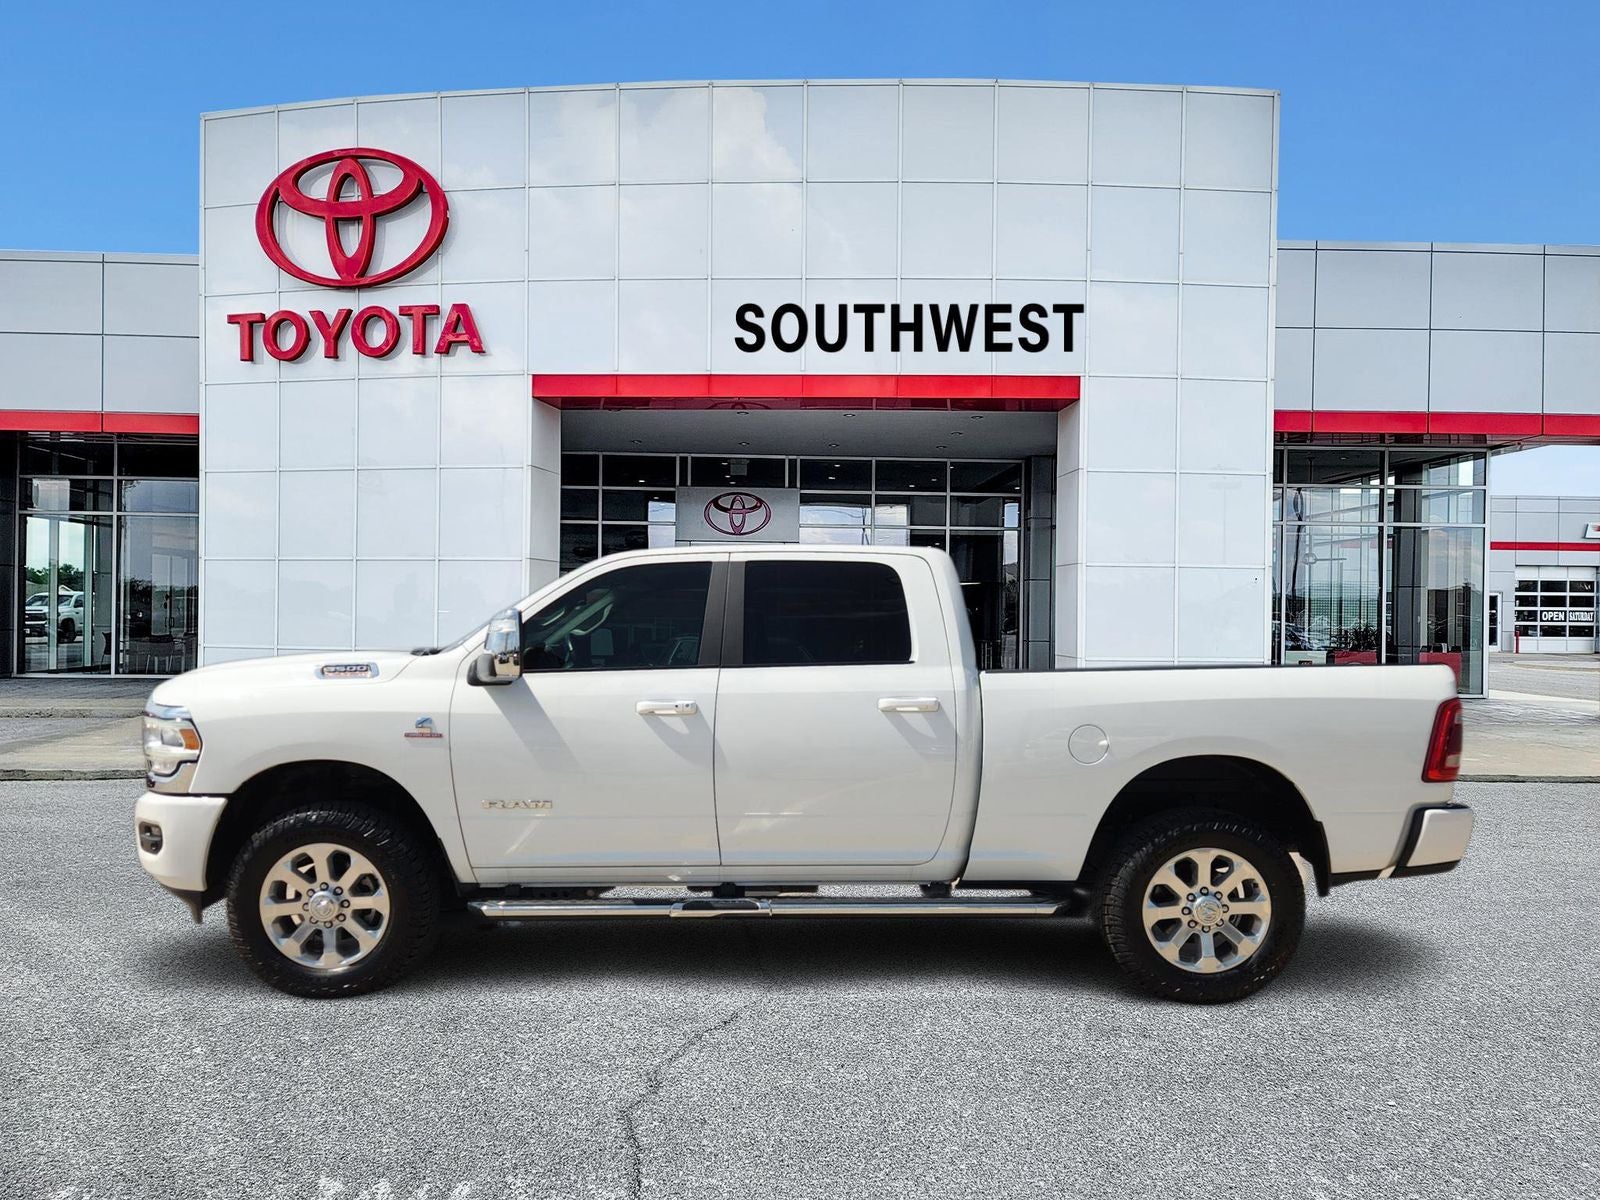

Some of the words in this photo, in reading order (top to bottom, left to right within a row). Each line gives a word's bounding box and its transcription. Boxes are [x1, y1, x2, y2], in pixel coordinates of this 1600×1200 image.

[227, 303, 486, 362] TOYOTA
[734, 303, 1085, 353] SOUTHWEST
[1542, 611, 1565, 621] OPEN
[481, 799, 553, 810] RAM
